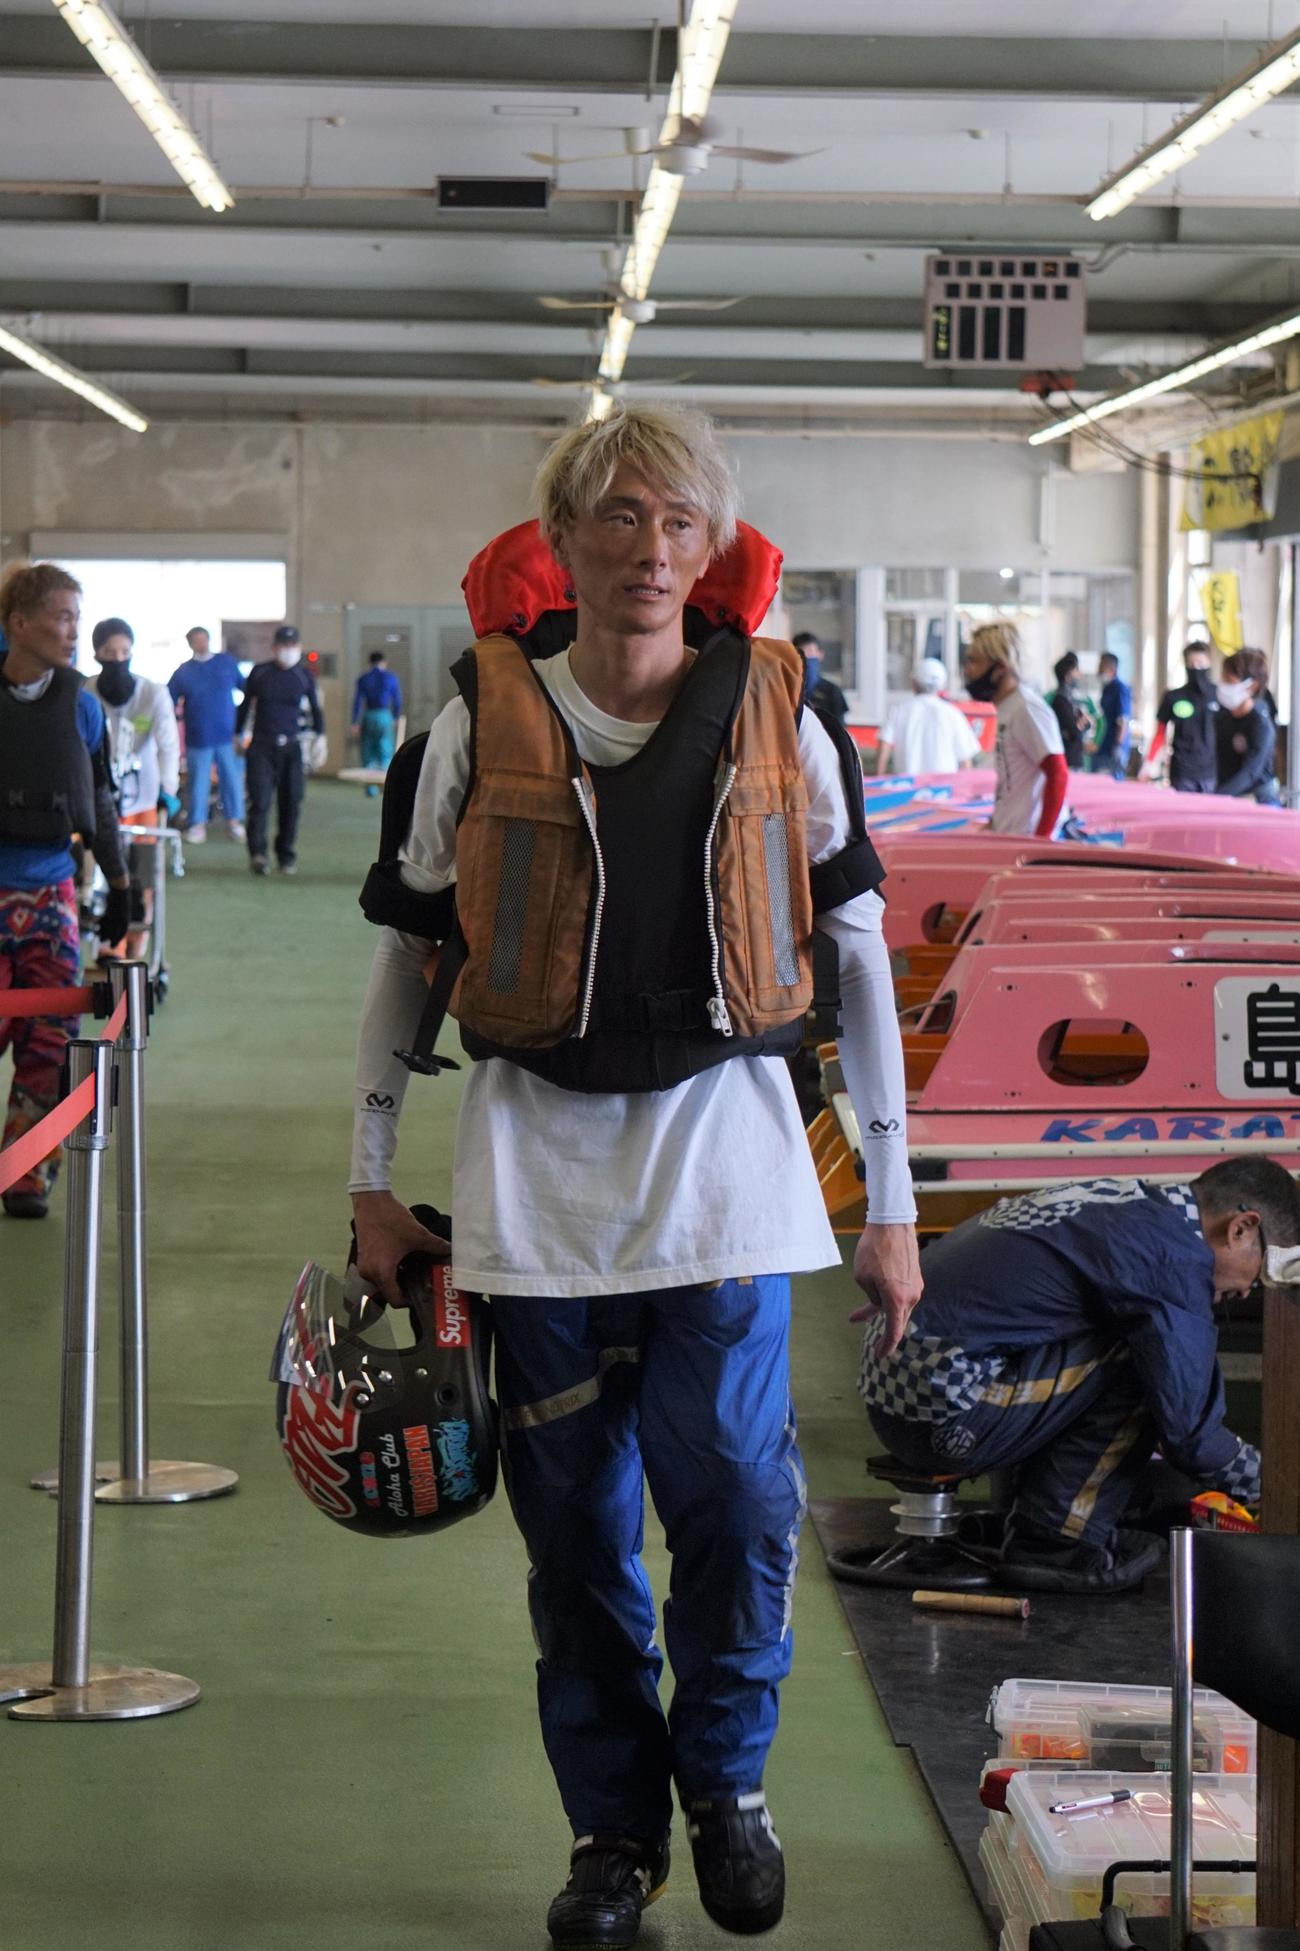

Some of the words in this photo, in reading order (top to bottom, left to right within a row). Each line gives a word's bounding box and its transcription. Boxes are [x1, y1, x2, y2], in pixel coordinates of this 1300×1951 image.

[1040, 1115, 1300, 1143] KARA
[439, 1265, 467, 1345] Supreme
[379, 1433, 401, 1468] Club
[386, 1473, 410, 1517] Aloha
